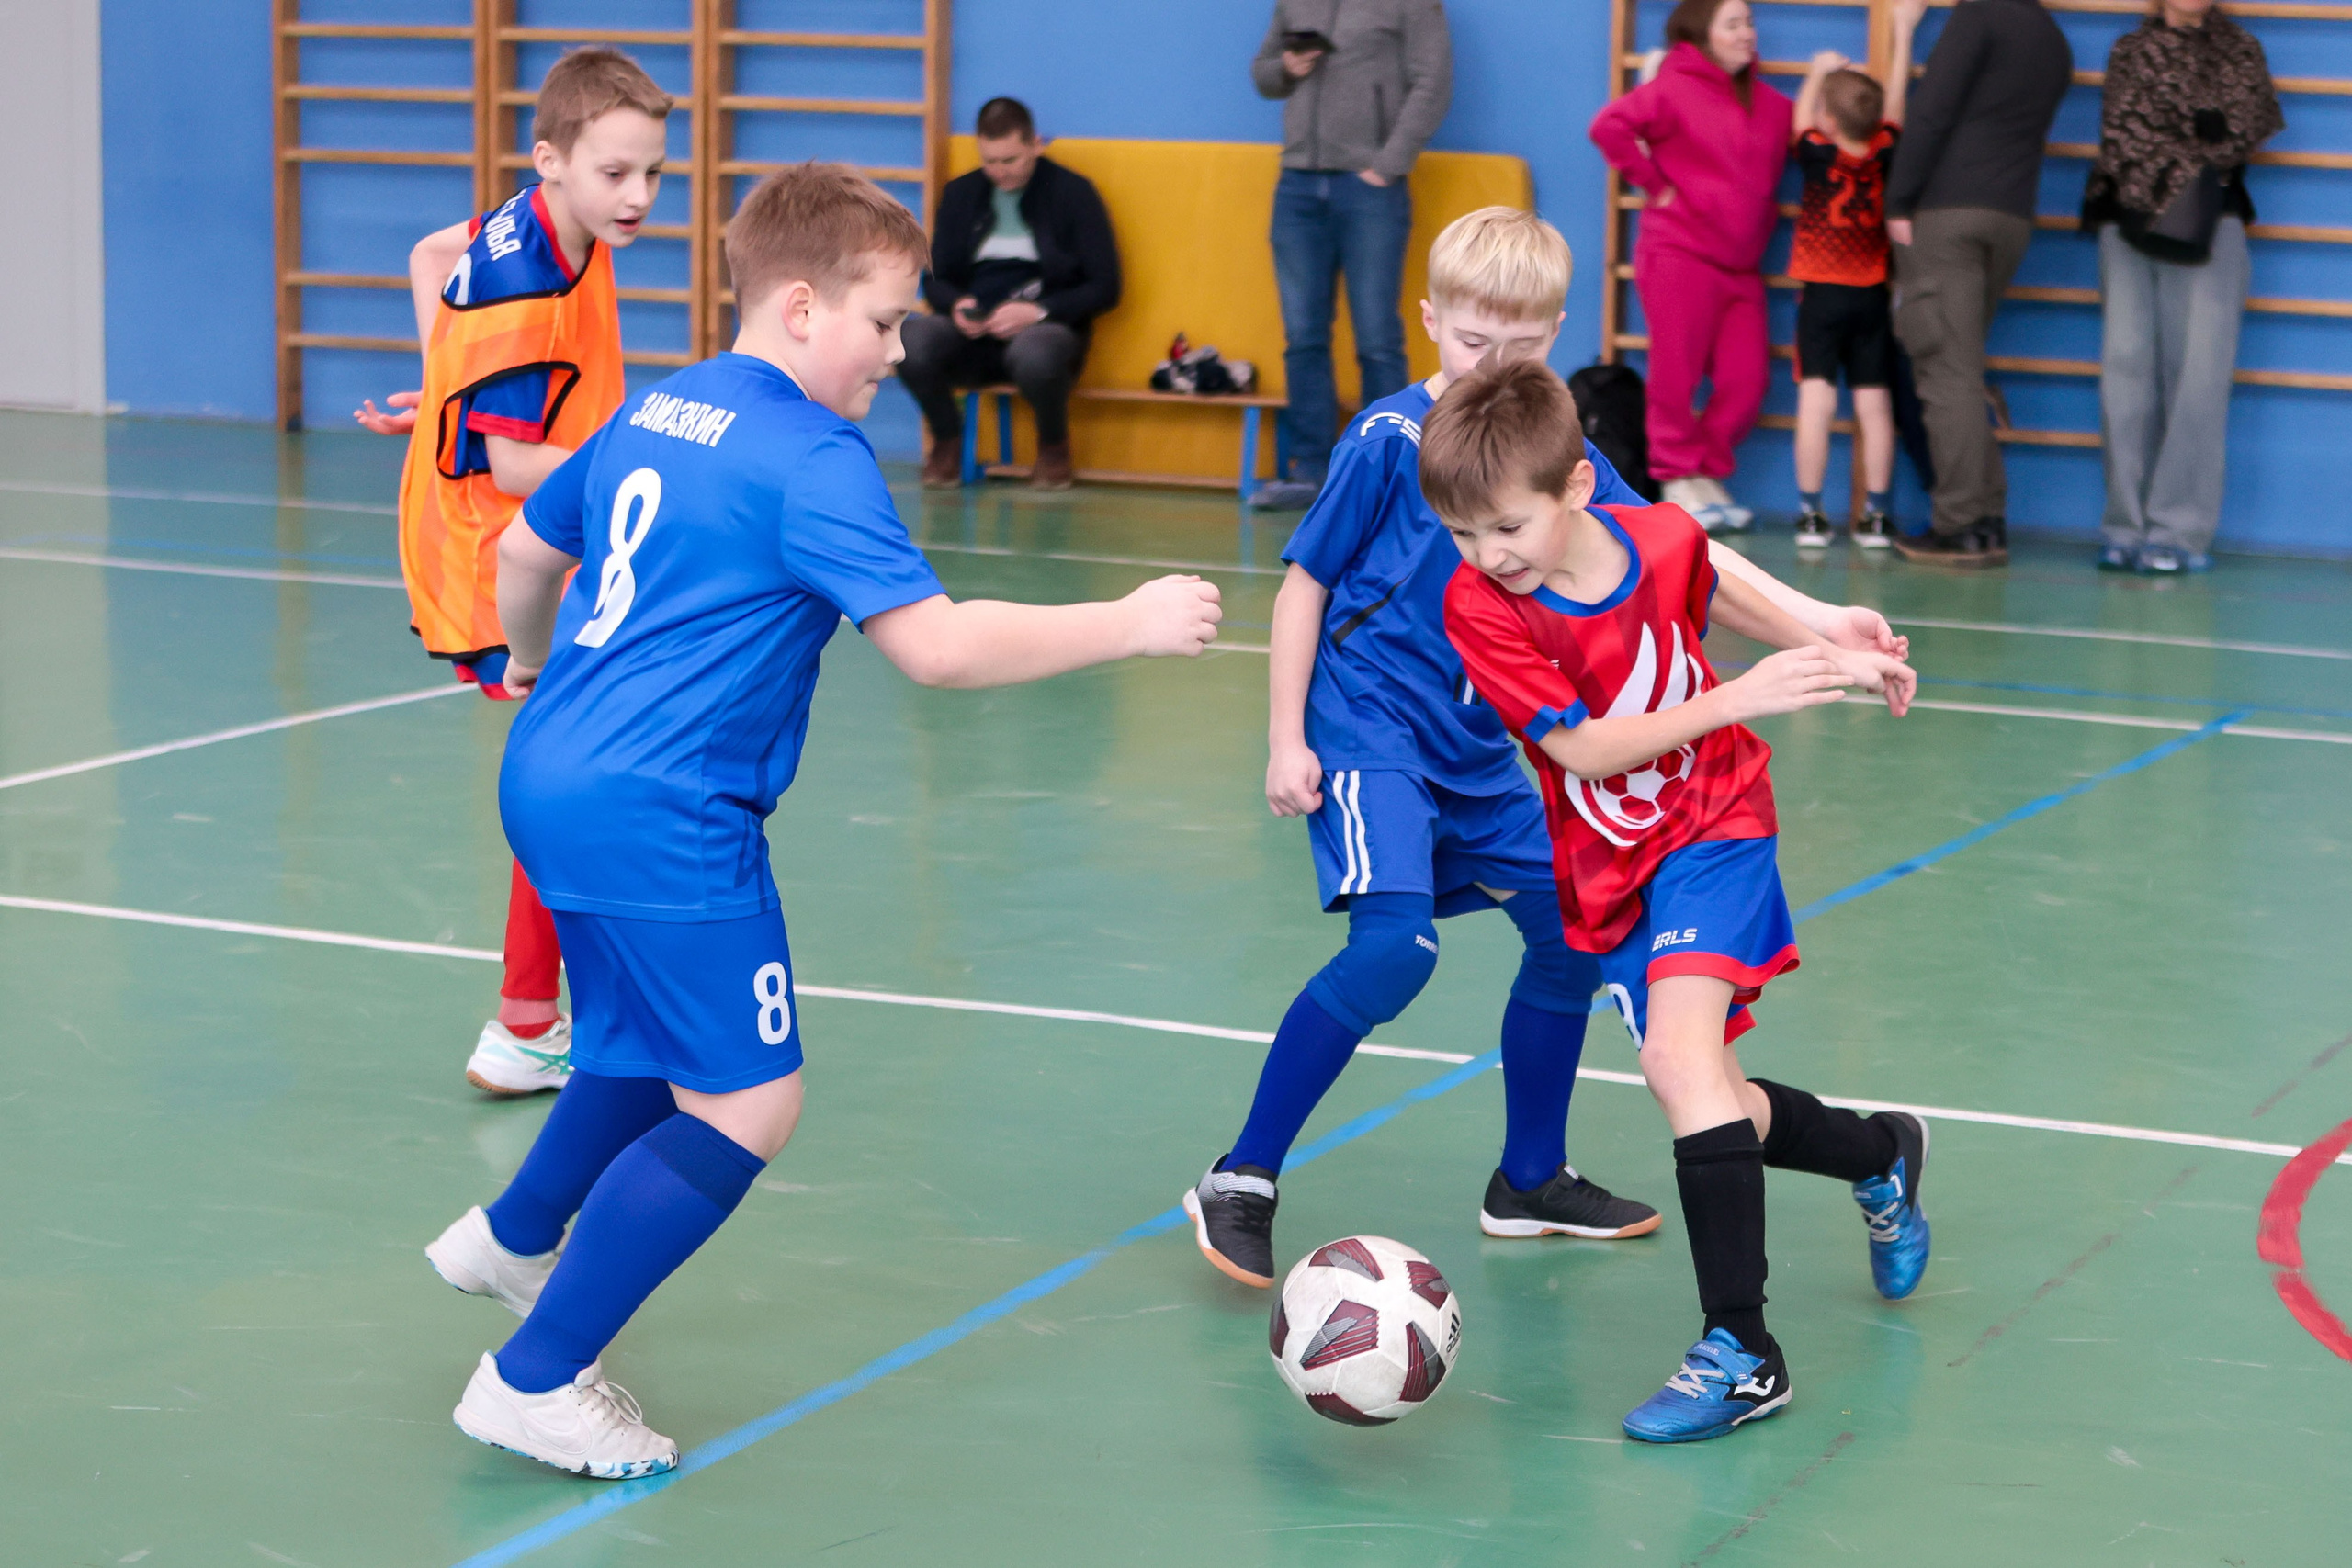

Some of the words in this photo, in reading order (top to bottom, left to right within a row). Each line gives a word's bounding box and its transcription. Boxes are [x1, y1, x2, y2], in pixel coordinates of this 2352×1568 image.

[629, 391, 737, 447] ЗАМАЗКИН
[573, 467, 662, 649] 8
[753, 961, 791, 1046] 8
